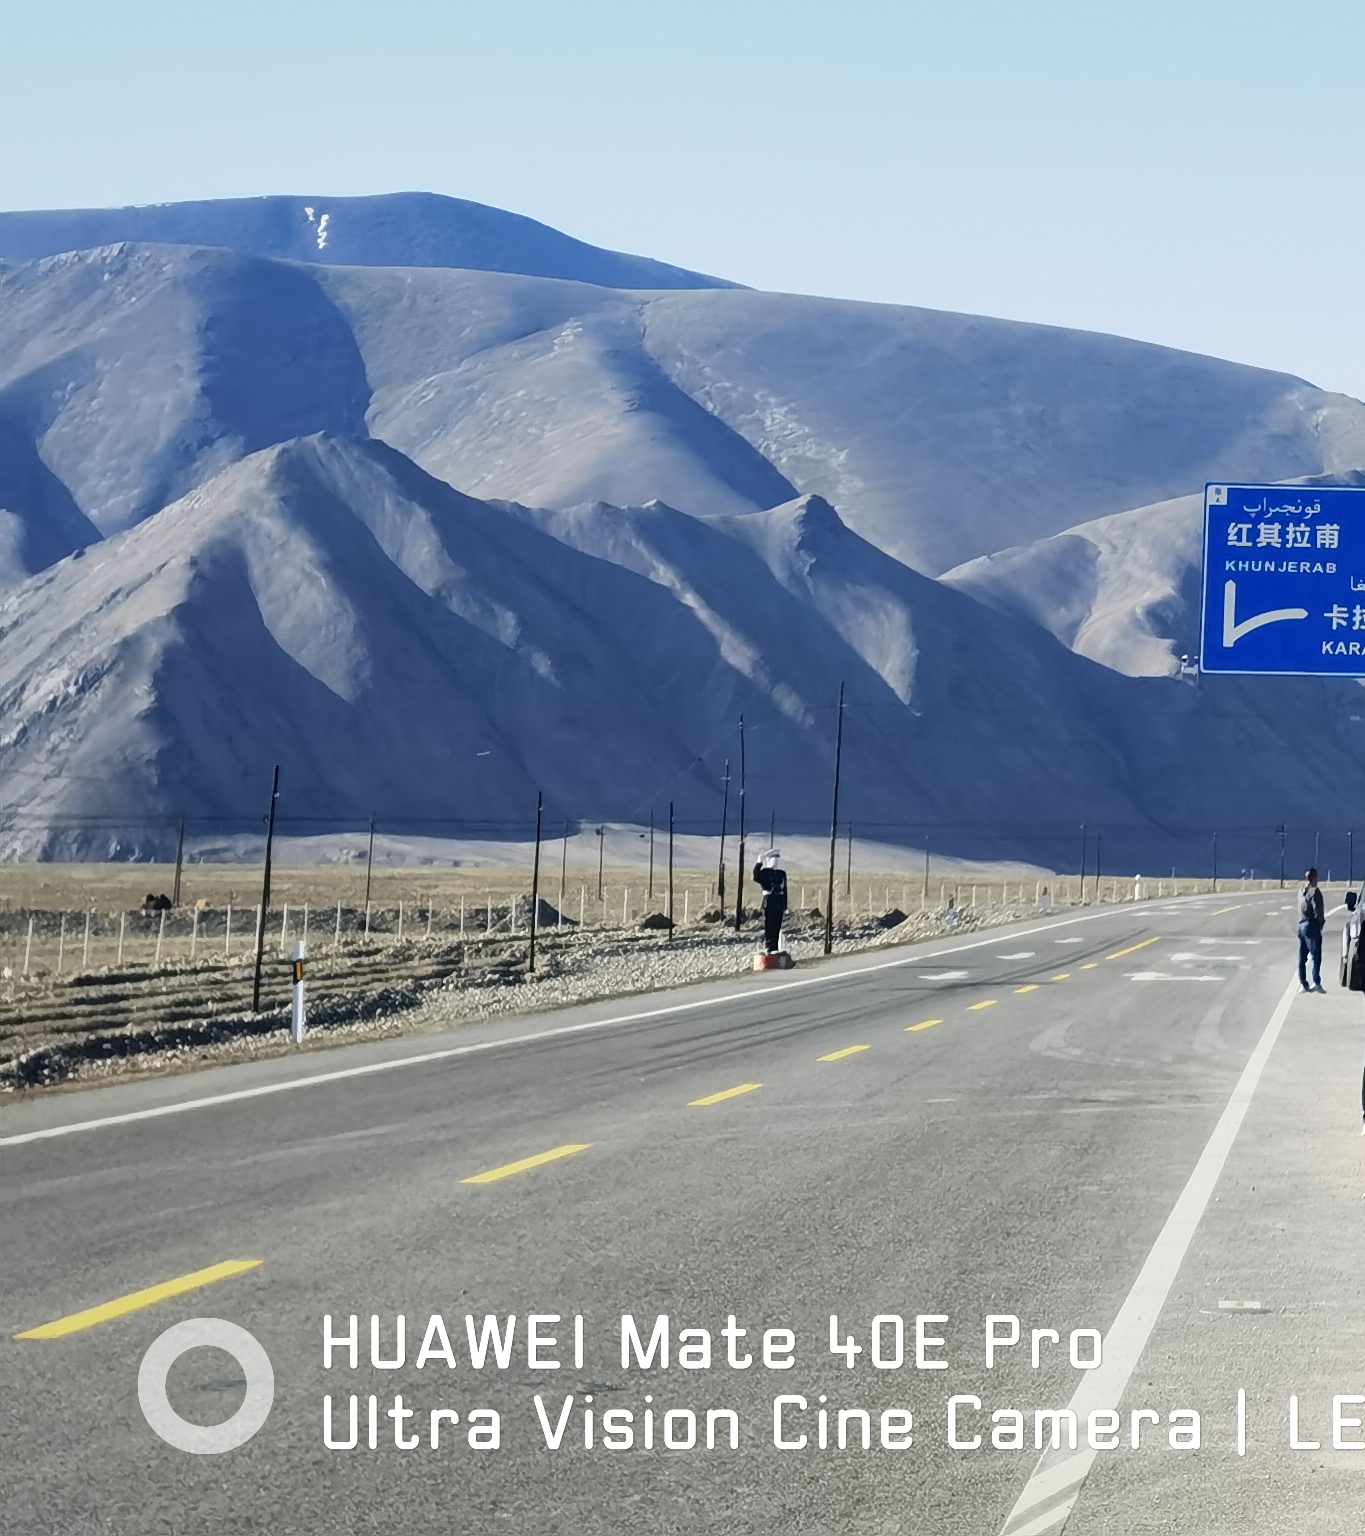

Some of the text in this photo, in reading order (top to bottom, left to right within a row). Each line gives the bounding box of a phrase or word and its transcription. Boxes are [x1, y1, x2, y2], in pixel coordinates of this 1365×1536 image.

[1227, 522, 1341, 549] 红其拉甫
[1225, 559, 1337, 574] KHUNJERAB
